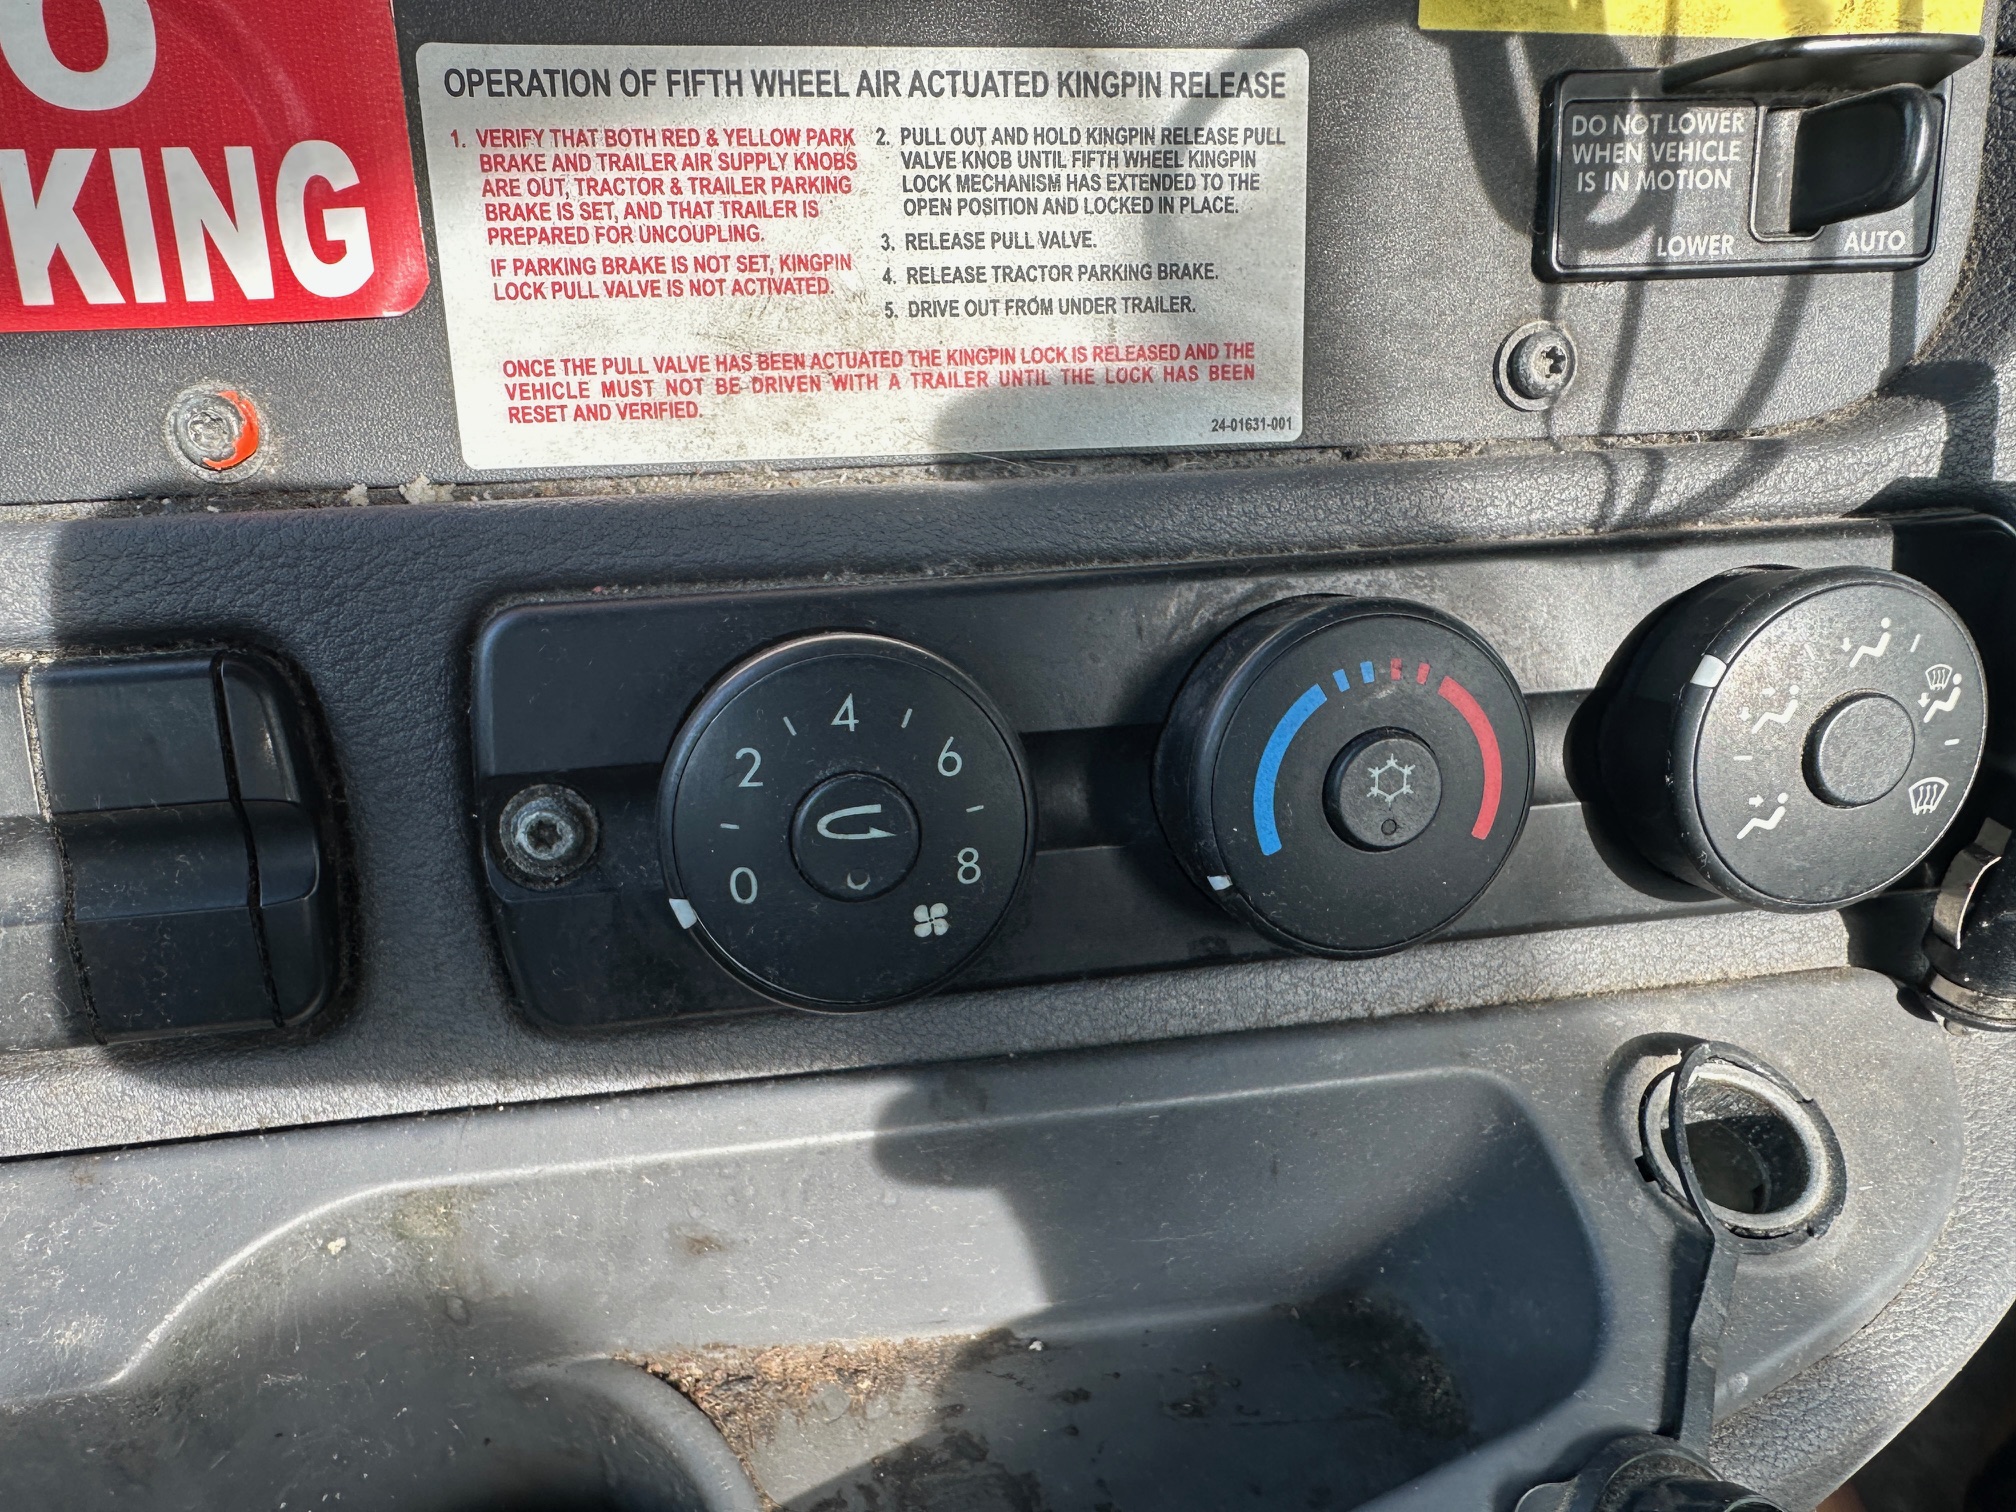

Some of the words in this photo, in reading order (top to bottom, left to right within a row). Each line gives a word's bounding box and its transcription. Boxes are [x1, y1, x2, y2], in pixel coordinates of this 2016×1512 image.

[444, 69, 610, 97] OPERATION
[620, 69, 656, 97] OF
[666, 69, 742, 97] FIFTH
[751, 70, 849, 97] WHEEL
[856, 70, 900, 97] AIR
[909, 70, 1048, 98] ACTUATED
[1058, 71, 1161, 98] KINGPIN
[1170, 71, 1286, 99] RELEASE
[1572, 115, 1606, 136] DO
[1613, 115, 1662, 135] NOT
[1668, 114, 1745, 134] LOWER
[450, 129, 466, 147] 1.
[476, 129, 544, 148] VERIFY
[550, 129, 600, 147] THAT
[605, 129, 657, 147] BOTH
[662, 129, 699, 147] RED
[707, 129, 718, 147] &
[723, 129, 801, 147] YELLOW
[807, 128, 856, 146] PARK
[876, 128, 890, 146] 2.
[900, 128, 945, 146] PULL
[950, 128, 987, 146] OUT
[992, 128, 1028, 145] AND
[1034, 128, 1081, 145] HOLD
[1086, 127, 1155, 145] KINGPIN
[1161, 128, 1238, 145] RELEASE
[1243, 128, 1285, 145] PULL
[480, 154, 546, 172] BRAKE
[552, 154, 591, 172] AND
[600, 153, 676, 172] TRAILER
[682, 153, 713, 171] AIR
[719, 152, 787, 171] SUPPLY
[794, 152, 857, 171] KNOBS
[900, 151, 956, 169] VALVE
[962, 151, 1012, 169] KNOB
[1017, 151, 1067, 169] UNTIL
[1072, 151, 1119, 168] FIFTH
[1123, 151, 1183, 168] WHEEL
[1189, 150, 1256, 168] KINGPIN
[1572, 142, 1641, 164] WHEN
[1650, 141, 1740, 162] VEHICLE
[483, 178, 520, 197] ARE
[527, 178, 569, 200] OUT,
[575, 177, 664, 196] TRACTOR
[670, 177, 682, 196] &
[690, 177, 766, 195] TRAILER
[771, 176, 851, 195] PARKING
[903, 175, 951, 193] LOCK
[956, 174, 1061, 192] MECHANISM
[1066, 174, 1101, 191] HAS
[1106, 174, 1196, 191] EXTENDED
[1201, 173, 1223, 191] TO
[1228, 173, 1260, 191] THE
[1578, 171, 1595, 192] IS
[1605, 170, 1629, 192] IN
[1636, 168, 1732, 191] MOTION
[486, 203, 551, 221] BRAKE
[557, 203, 574, 221] IS
[580, 202, 618, 222] SET,
[624, 201, 662, 220] AND
[668, 201, 715, 220] THAT
[720, 200, 797, 219] TRAILER
[803, 200, 818, 218] IS
[903, 198, 952, 216] OPEN
[958, 198, 1038, 216] POSITION
[1043, 197, 1078, 215] AND
[1084, 197, 1154, 214] LOCKED
[1159, 197, 1174, 214] IN
[1180, 196, 1238, 214] PLACE.
[488, 226, 589, 245] PREPARED
[595, 225, 633, 244] FOR
[639, 224, 764, 244] UNCOUPLING.
[880, 233, 894, 251] 3.
[905, 233, 985, 251] RELEASE
[991, 232, 1035, 250] PULL
[1039, 231, 1097, 249] VALVE.
[1657, 234, 1733, 256] LOWER
[1844, 231, 1906, 252] AUTO
[491, 258, 507, 276] IF
[513, 257, 596, 276] PARKING
[603, 256, 666, 275] BRAKE
[672, 256, 688, 274] IS
[694, 255, 731, 274] NOT
[737, 255, 774, 274] SET,
[780, 254, 852, 272] KINGPIN
[882, 267, 896, 284] 4.
[907, 266, 986, 284] RELEASE
[992, 265, 1073, 283] TRACTOR
[1078, 263, 1152, 281] PARKING
[1157, 263, 1218, 280] BRAKE.
[494, 281, 548, 301] LOCK
[552, 281, 599, 300] PULL
[604, 280, 661, 299] VALVE
[667, 279, 683, 297] IS
[689, 279, 726, 297] NOT
[732, 278, 835, 296] ACTIVATED.
[884, 301, 898, 318] 5.
[908, 299, 959, 318] DRIVE
[965, 299, 1000, 317] OUT
[1005, 297, 1053, 316] FROM
[1059, 297, 1116, 315] UNDER
[1121, 295, 1196, 313] TRAILER.
[503, 359, 555, 377] ONCE
[561, 358, 596, 375] THE
[603, 357, 649, 375] PULL
[653, 355, 709, 373] VALVE
[716, 354, 753, 372] HAS
[758, 353, 806, 371] BEEN
[809, 350, 901, 369] ACTUATED
[908, 349, 943, 367] THE
[947, 348, 1016, 366] KINGPIN
[1021, 346, 1067, 364] LOCK
[1072, 346, 1088, 363] IS
[1093, 345, 1180, 362] RELEASED
[1185, 344, 1219, 361] AND
[1224, 343, 1254, 360] THE
[505, 382, 590, 400] VEHICLE
[601, 380, 653, 398] MUST
[666, 379, 704, 396] NOT
[716, 377, 740, 395] BE
[752, 375, 821, 393] DRIVEN
[832, 374, 879, 392] WITH
[889, 373, 901, 390] A
[911, 371, 988, 389] TRAILER
[1000, 370, 1051, 387] UNTIL
[1060, 368, 1095, 385] THE
[1106, 367, 1153, 384] LOCK
[1163, 366, 1199, 382] HAS
[1209, 364, 1255, 382] BEEN
[508, 406, 568, 424] RESET
[574, 404, 611, 421] AND
[1211, 417, 1292, 432] 24-01631-001
[831, 693, 859, 732] 4
[735, 747, 763, 787] 2
[937, 736, 962, 776] 6
[957, 847, 981, 884] 8
[729, 866, 757, 904] 0
